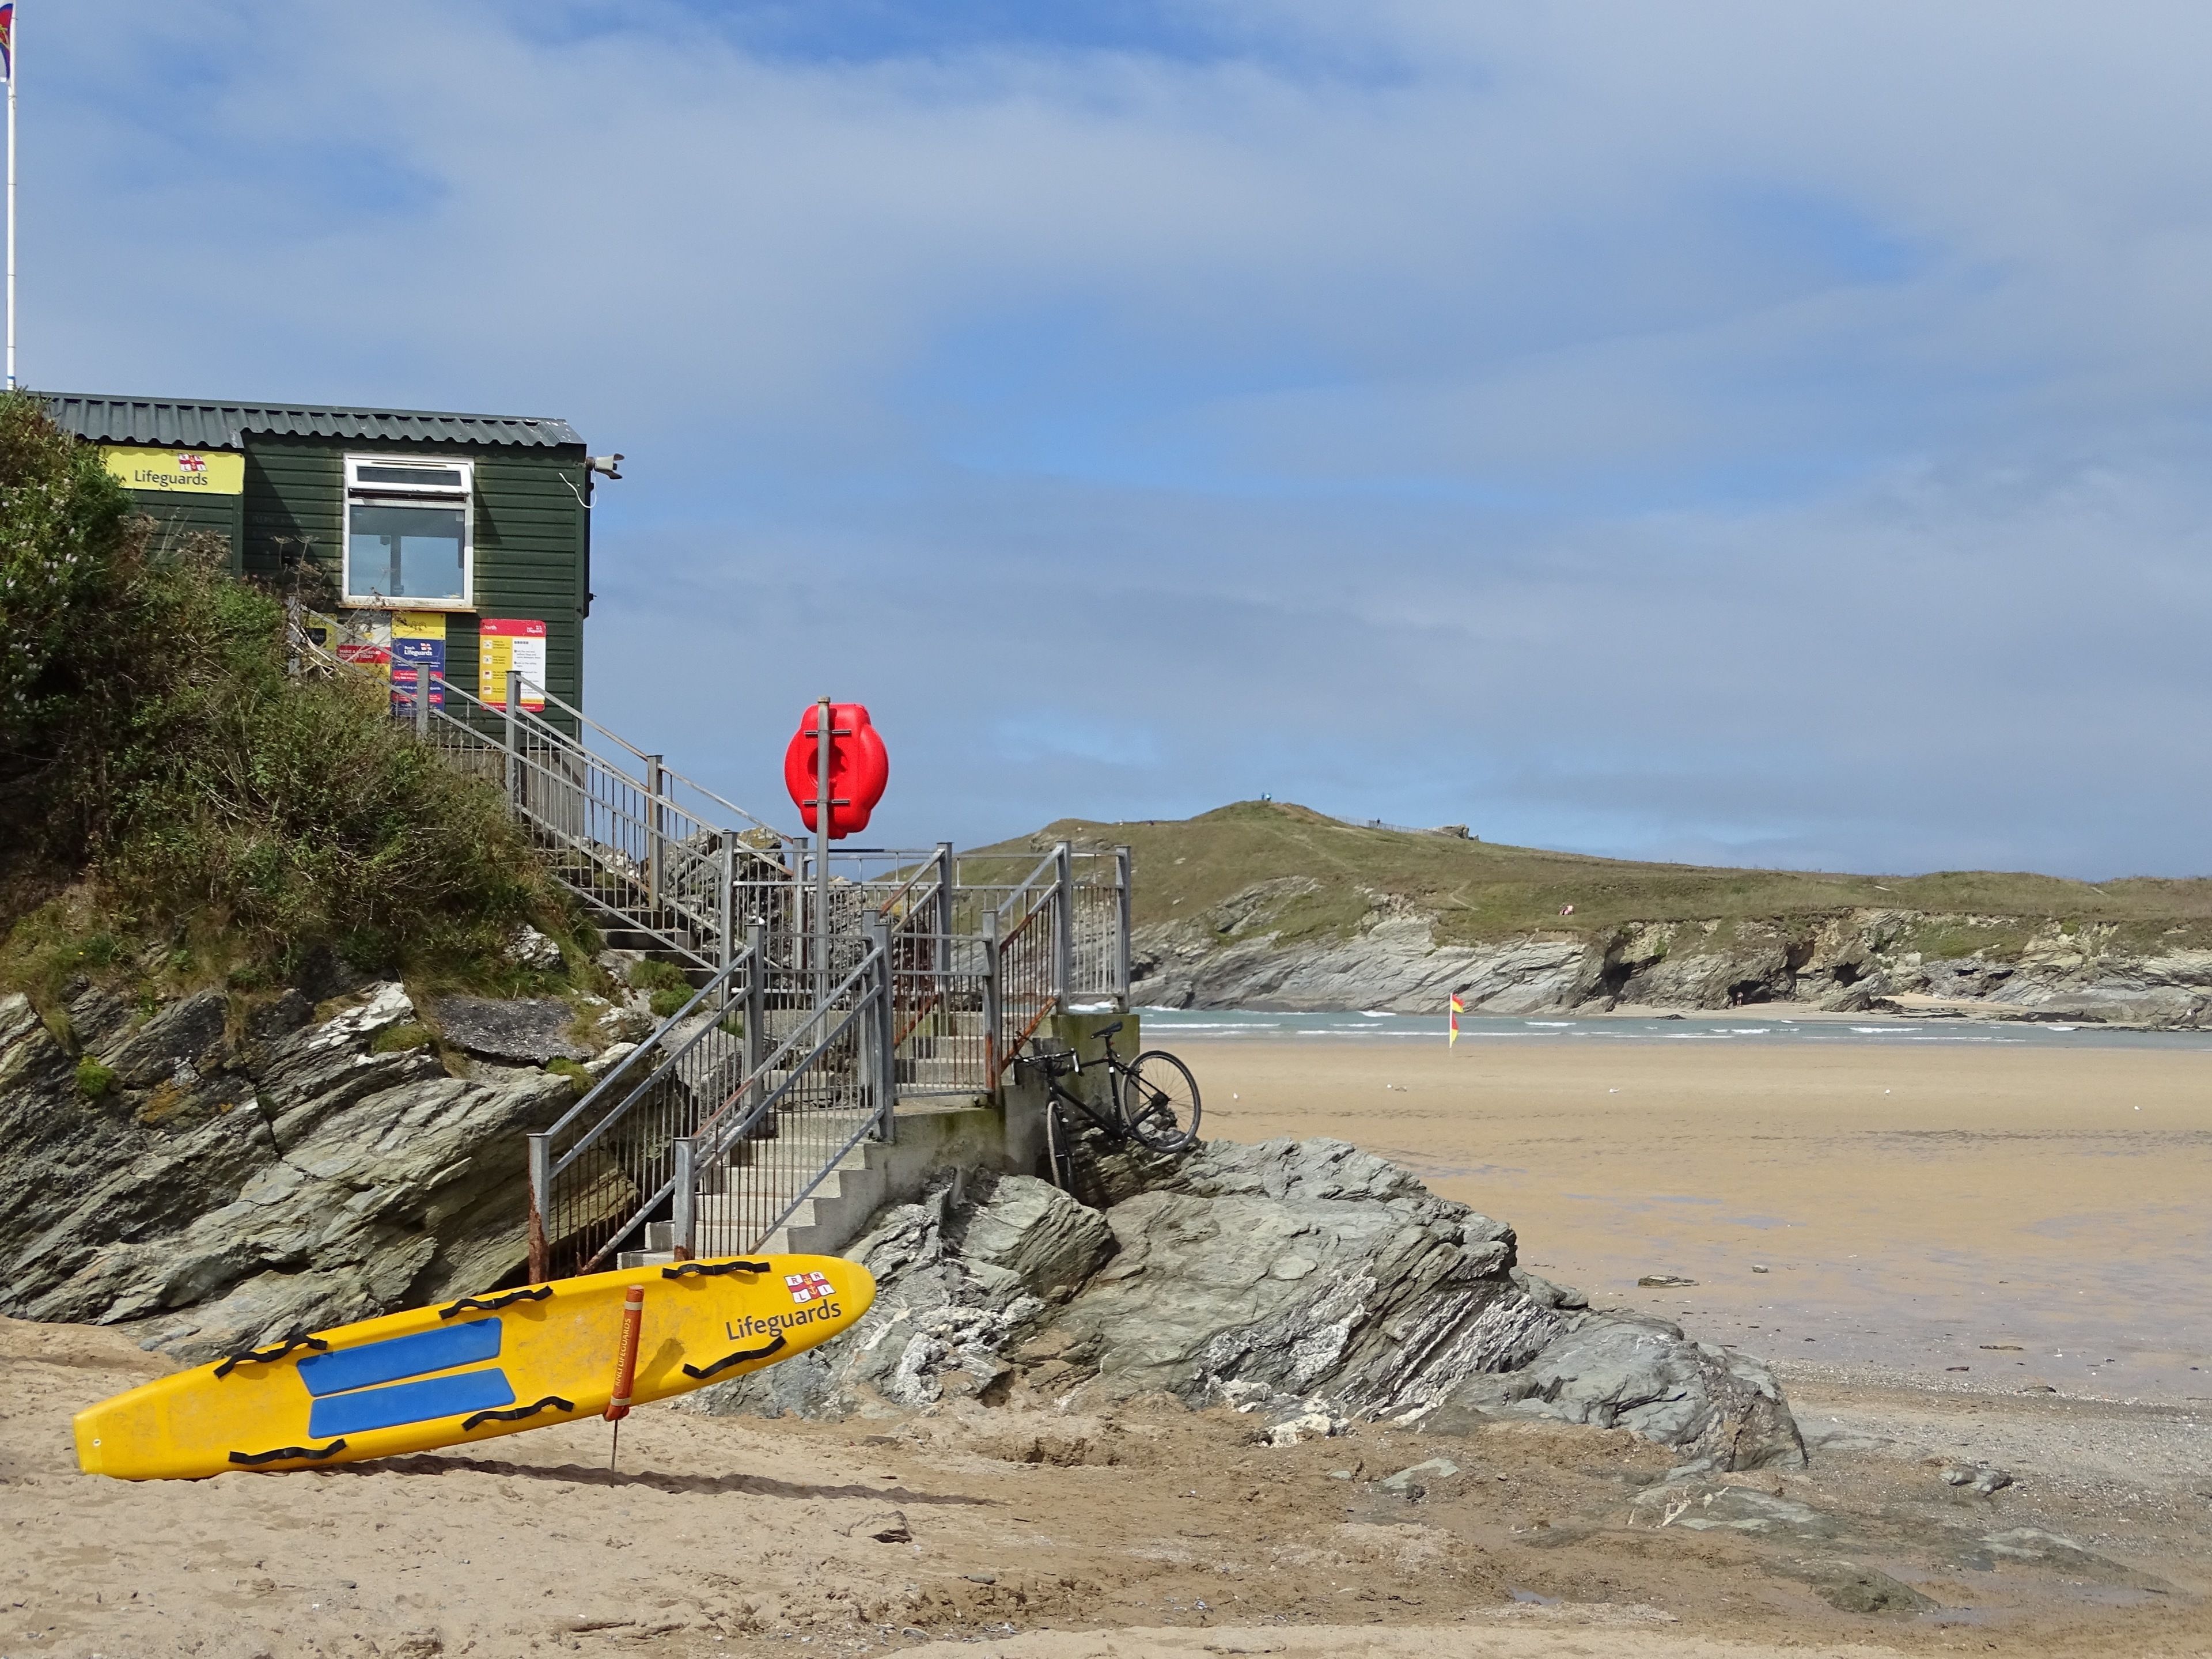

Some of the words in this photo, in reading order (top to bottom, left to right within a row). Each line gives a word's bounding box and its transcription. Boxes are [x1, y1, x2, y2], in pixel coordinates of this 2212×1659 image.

[134, 469, 208, 487] Lifeguards
[726, 1299, 842, 1342] Lifeguards
[618, 1318, 631, 1367] LIFEGUARDS
